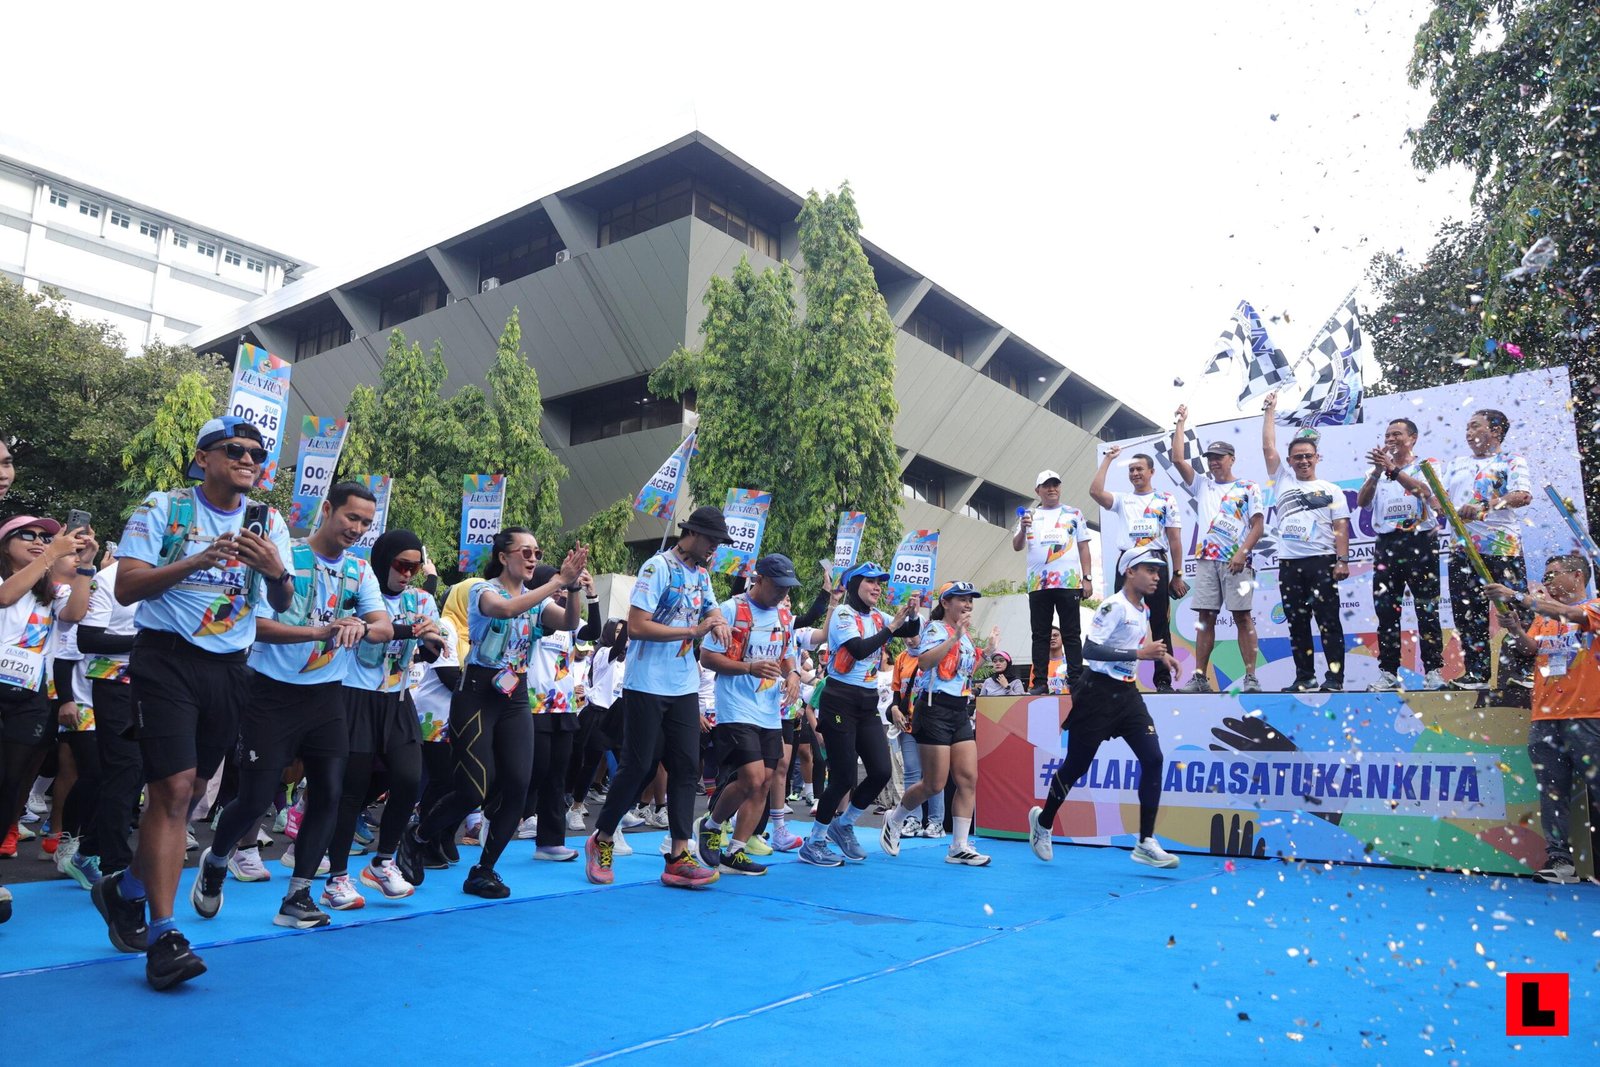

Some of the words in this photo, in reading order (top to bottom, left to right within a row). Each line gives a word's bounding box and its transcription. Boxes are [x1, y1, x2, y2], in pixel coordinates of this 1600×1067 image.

[264, 404, 279, 416] SUB
[233, 404, 278, 431] 00:45
[651, 478, 675, 492] ACER
[1388, 504, 1411, 512] 00019
[466, 533, 495, 544] PAC
[896, 562, 929, 574] 00:35
[893, 574, 930, 585] PACER
[1, 658, 34, 675] 01201
[1040, 758, 1479, 802] #LAHAGASATUKANKITA
